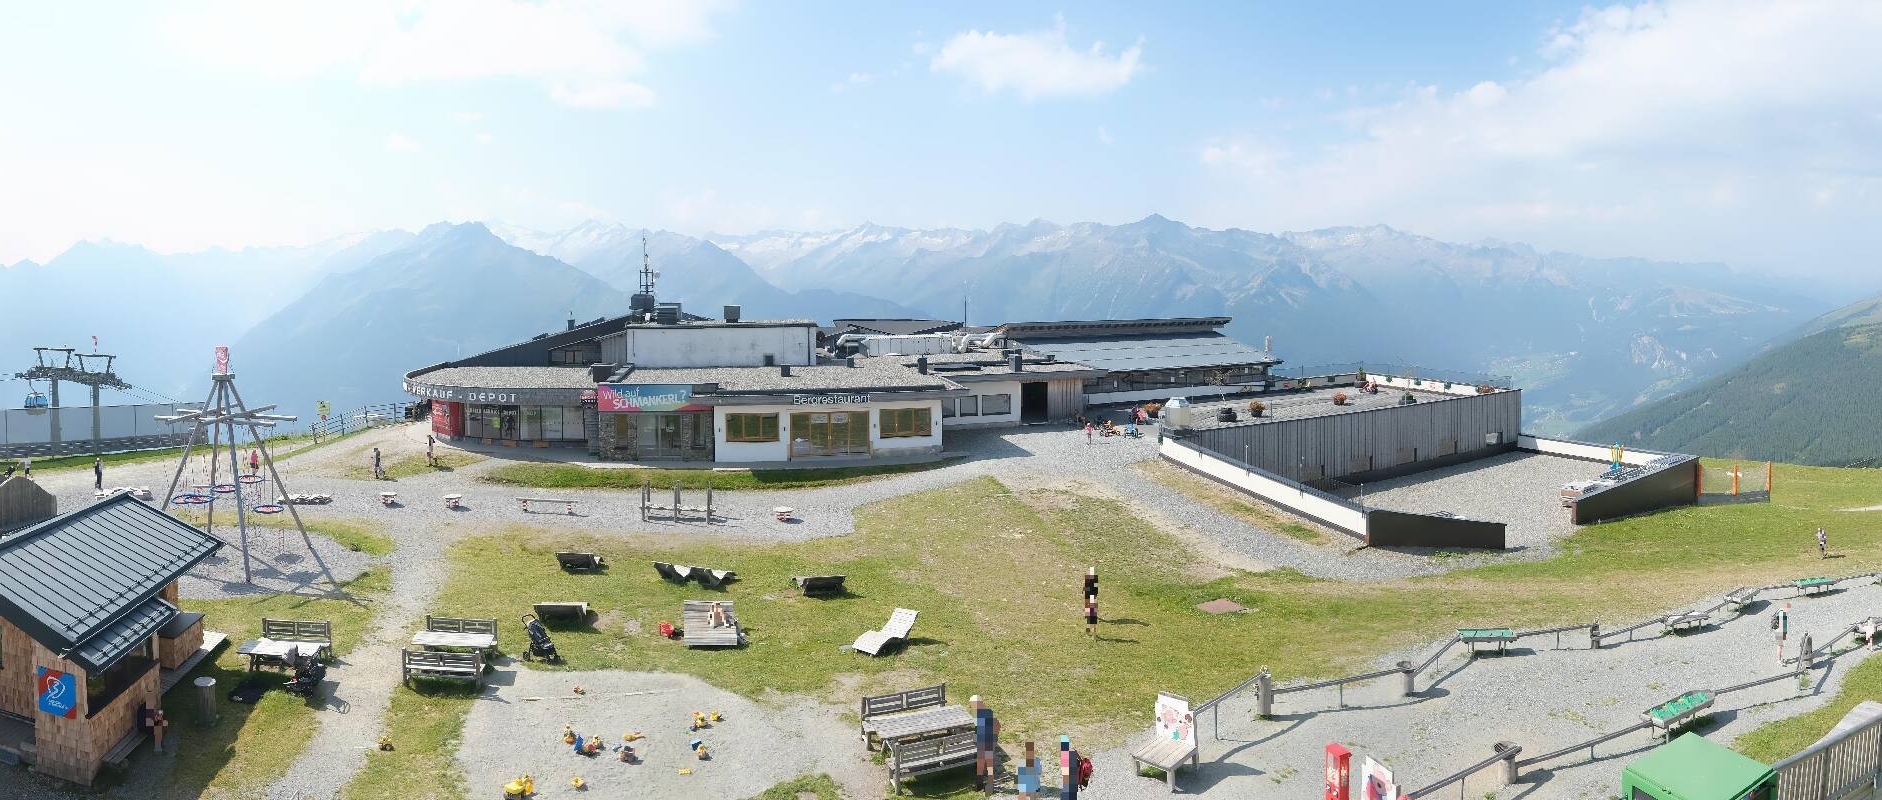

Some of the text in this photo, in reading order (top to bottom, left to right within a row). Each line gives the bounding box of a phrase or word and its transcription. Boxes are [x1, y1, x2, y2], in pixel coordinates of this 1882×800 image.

[469, 392, 517, 402] DEPOT
[602, 389, 623, 400] Wild
[625, 387, 639, 397] auf
[613, 390, 687, 410] SCHMANKERL?
[793, 394, 871, 406] Bergrestaurant
